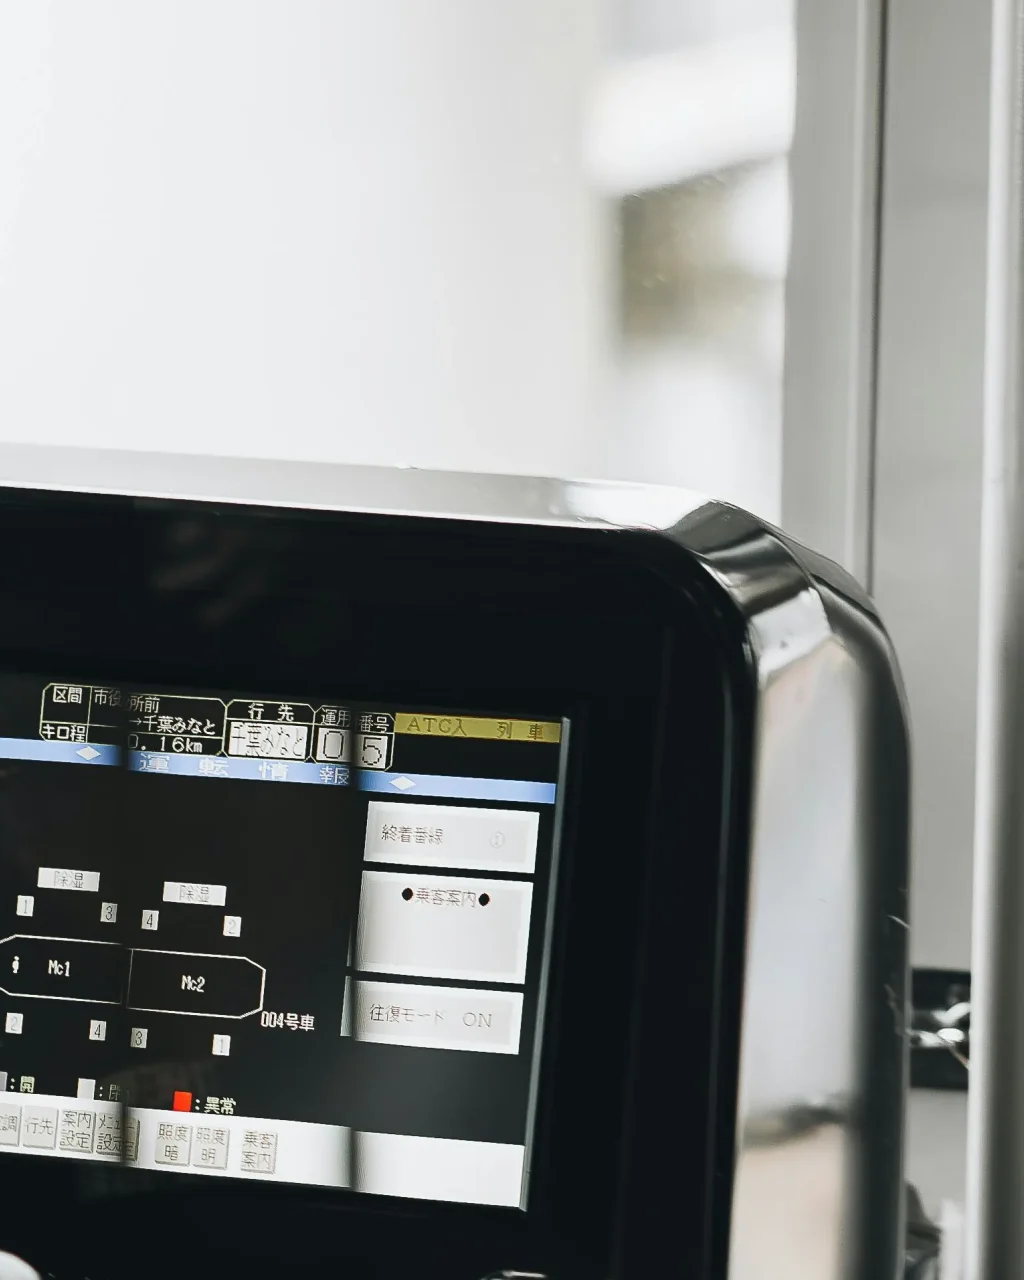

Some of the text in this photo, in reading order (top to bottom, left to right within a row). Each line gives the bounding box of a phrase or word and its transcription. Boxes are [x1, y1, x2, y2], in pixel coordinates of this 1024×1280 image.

[53, 686, 161, 713] 区間 市役所前
[248, 703, 295, 722] 行先
[320, 708, 390, 734] 運用番号
[42, 724, 86, 743] キロ程
[143, 715, 216, 736] 千葉みなと
[406, 717, 467, 736] ATC入
[323, 731, 383, 766] 05
[104, 905, 114, 921] 3
[145, 913, 155, 928] 4
[48, 959, 71, 977] Mc1
[181, 975, 206, 993] Mc2
[9, 1016, 18, 1032] 2
[260, 1011, 315, 1032] 004号車
[369, 1003, 493, 1028] 往復モード ON
[93, 1023, 102, 1039] 4
[134, 1030, 144, 1046] 3
[24, 1117, 54, 1136] 行先
[62, 1109, 92, 1129] 案内
[59, 1129, 91, 1150] 設定
[158, 1123, 189, 1143] 照度
[195, 1127, 225, 1146] 照度
[242, 1130, 274, 1150] 乗客
[164, 1145, 179, 1161] 暗
[200, 1148, 216, 1165] 明
[242, 1151, 272, 1170] 案内
